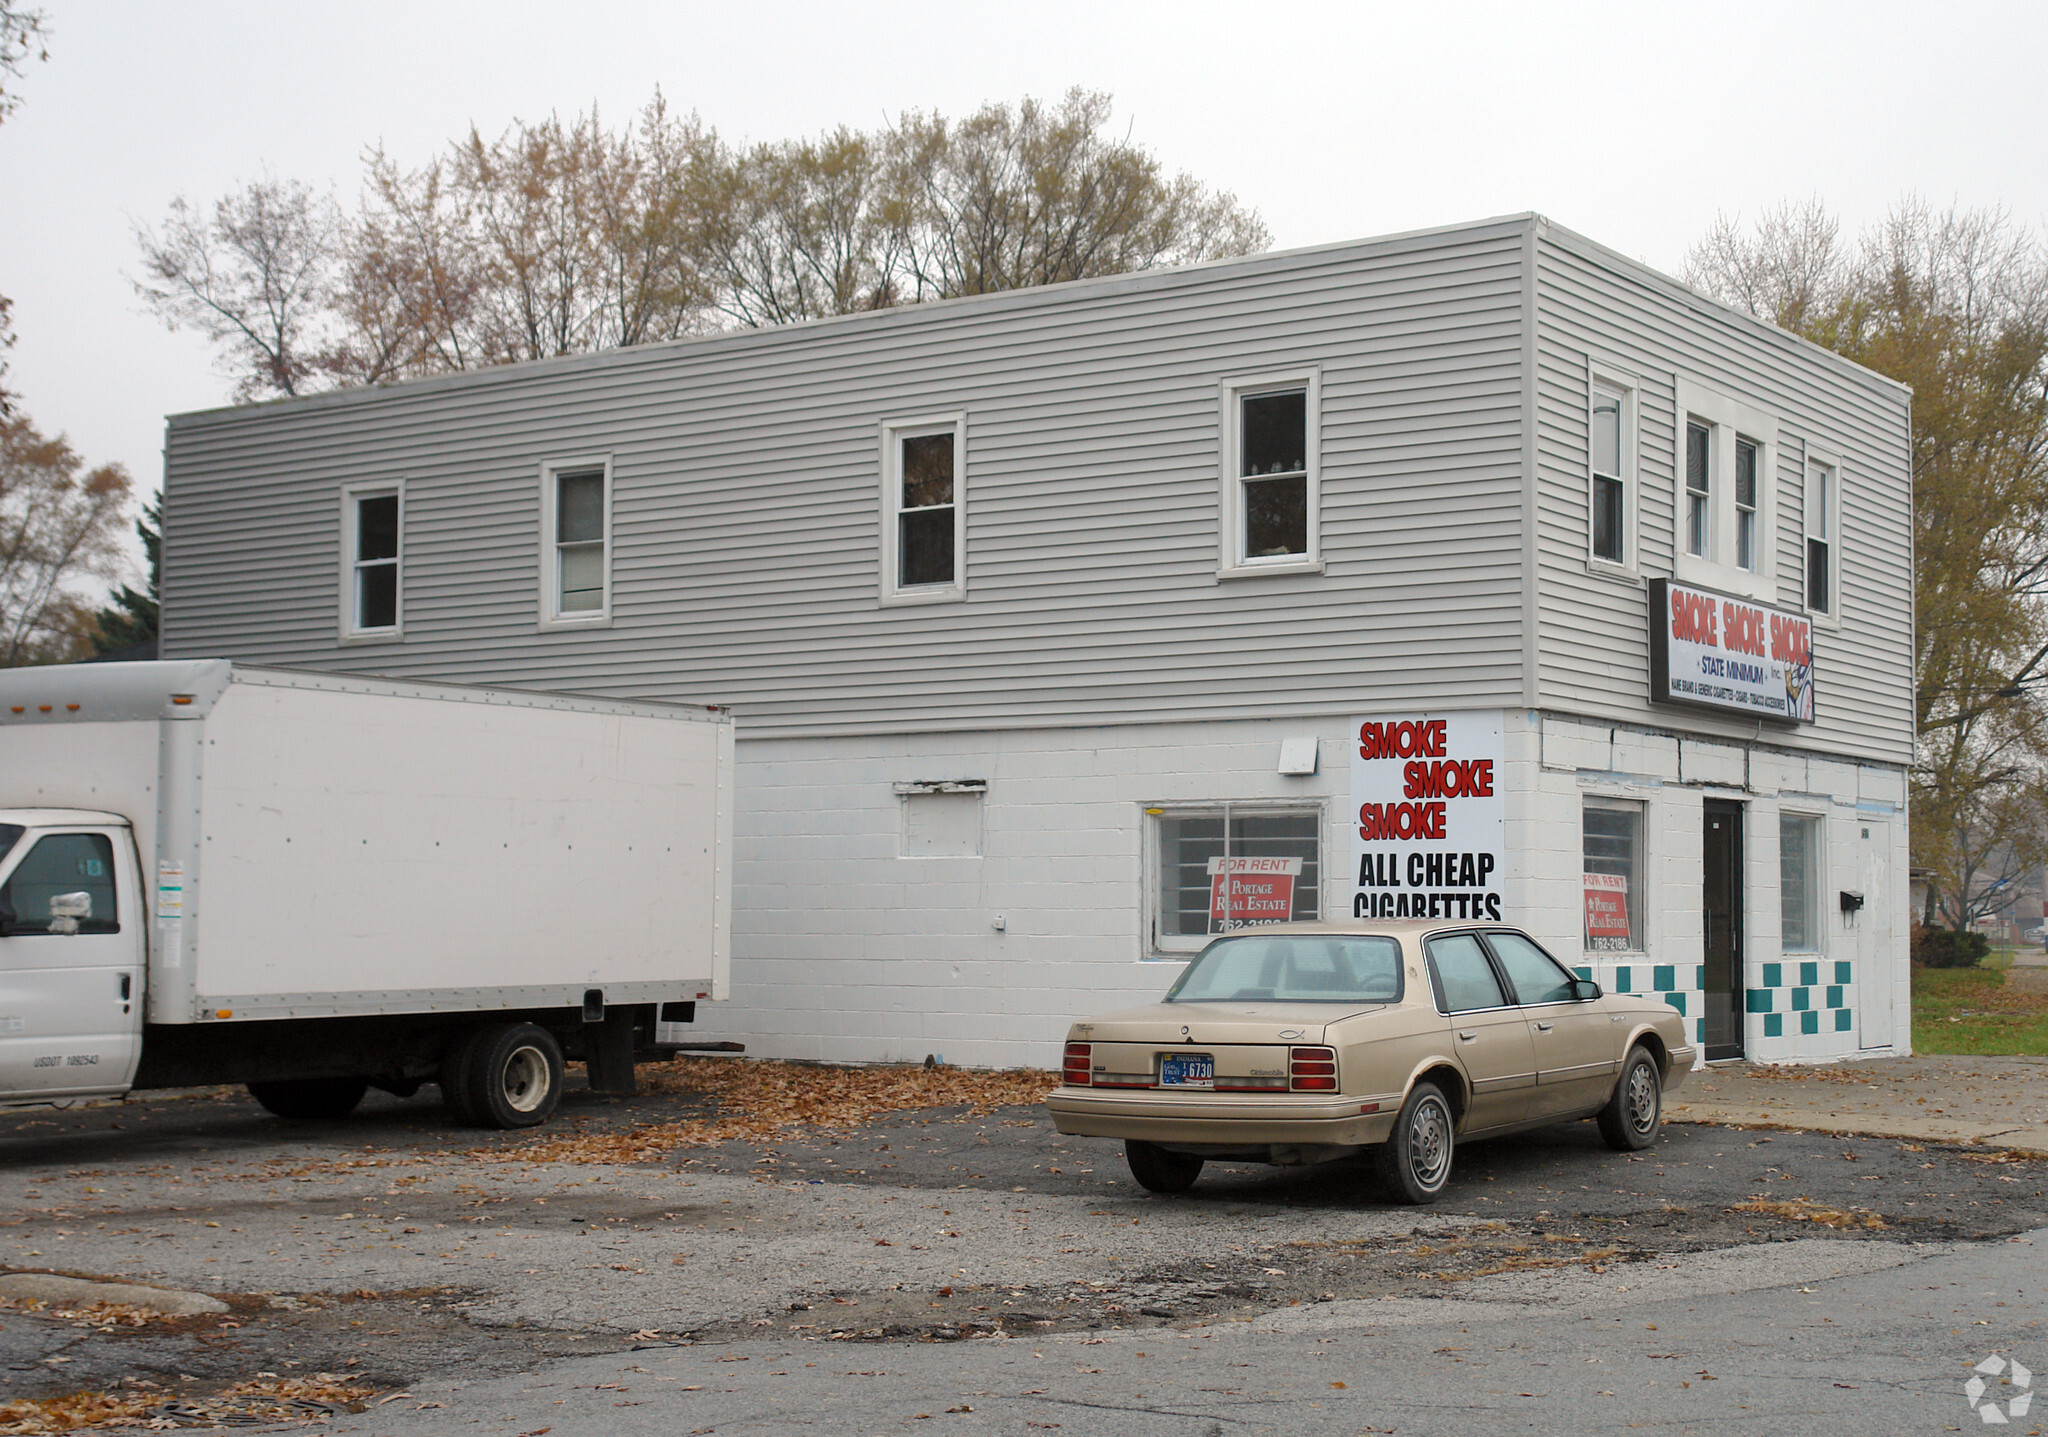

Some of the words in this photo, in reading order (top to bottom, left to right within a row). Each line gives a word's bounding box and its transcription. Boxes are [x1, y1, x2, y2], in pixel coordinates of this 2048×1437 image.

[1672, 588, 1717, 647] SMOKE
[1723, 601, 1765, 657] SMOKE
[1770, 613, 1809, 666] SMOKE
[1702, 655, 1724, 677] STATE
[1726, 660, 1763, 685] MINIMUM
[1359, 719, 1447, 760] SMOKE
[1403, 759, 1494, 799] SMOKE
[1359, 801, 1447, 841] SMOKE
[1218, 859, 1247, 871] FOR
[1250, 859, 1290, 871] RENT
[1358, 853, 1401, 887] ALL
[1407, 852, 1495, 887] CHEAP
[1582, 874, 1601, 886] FOR
[1602, 875, 1624, 888] RENT
[1246, 896, 1287, 911] ESTATE
[1353, 892, 1501, 921] CIGARETTES
[1593, 937, 1628, 949] 762-2186
[33, 1055, 62, 1068] USDOT
[1189, 1062, 1213, 1078] 6730
